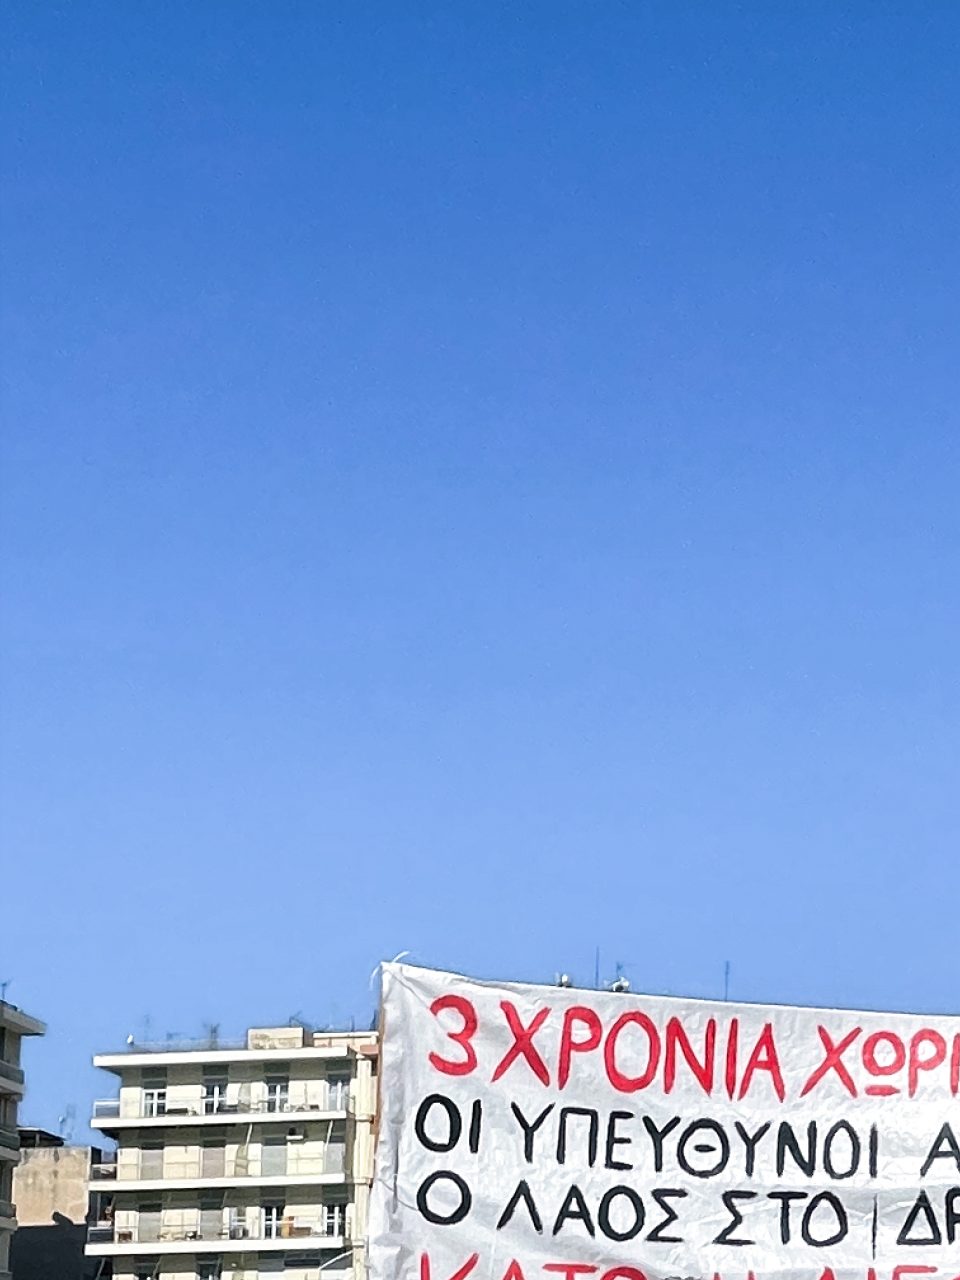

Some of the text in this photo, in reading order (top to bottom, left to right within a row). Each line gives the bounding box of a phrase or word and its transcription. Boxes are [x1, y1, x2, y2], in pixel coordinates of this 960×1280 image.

[428, 994, 478, 1077] 3
[490, 999, 786, 1102] ΧΡΟΝΙΑ
[414, 1093, 483, 1155] ΟΙ
[510, 1100, 879, 1180] ΥΠΕΥΘΥΝΟΙ
[415, 1169, 473, 1226] Ο
[496, 1179, 690, 1245] ΛΑΟΣ
[712, 1189, 850, 1248] ΣΤΟ
